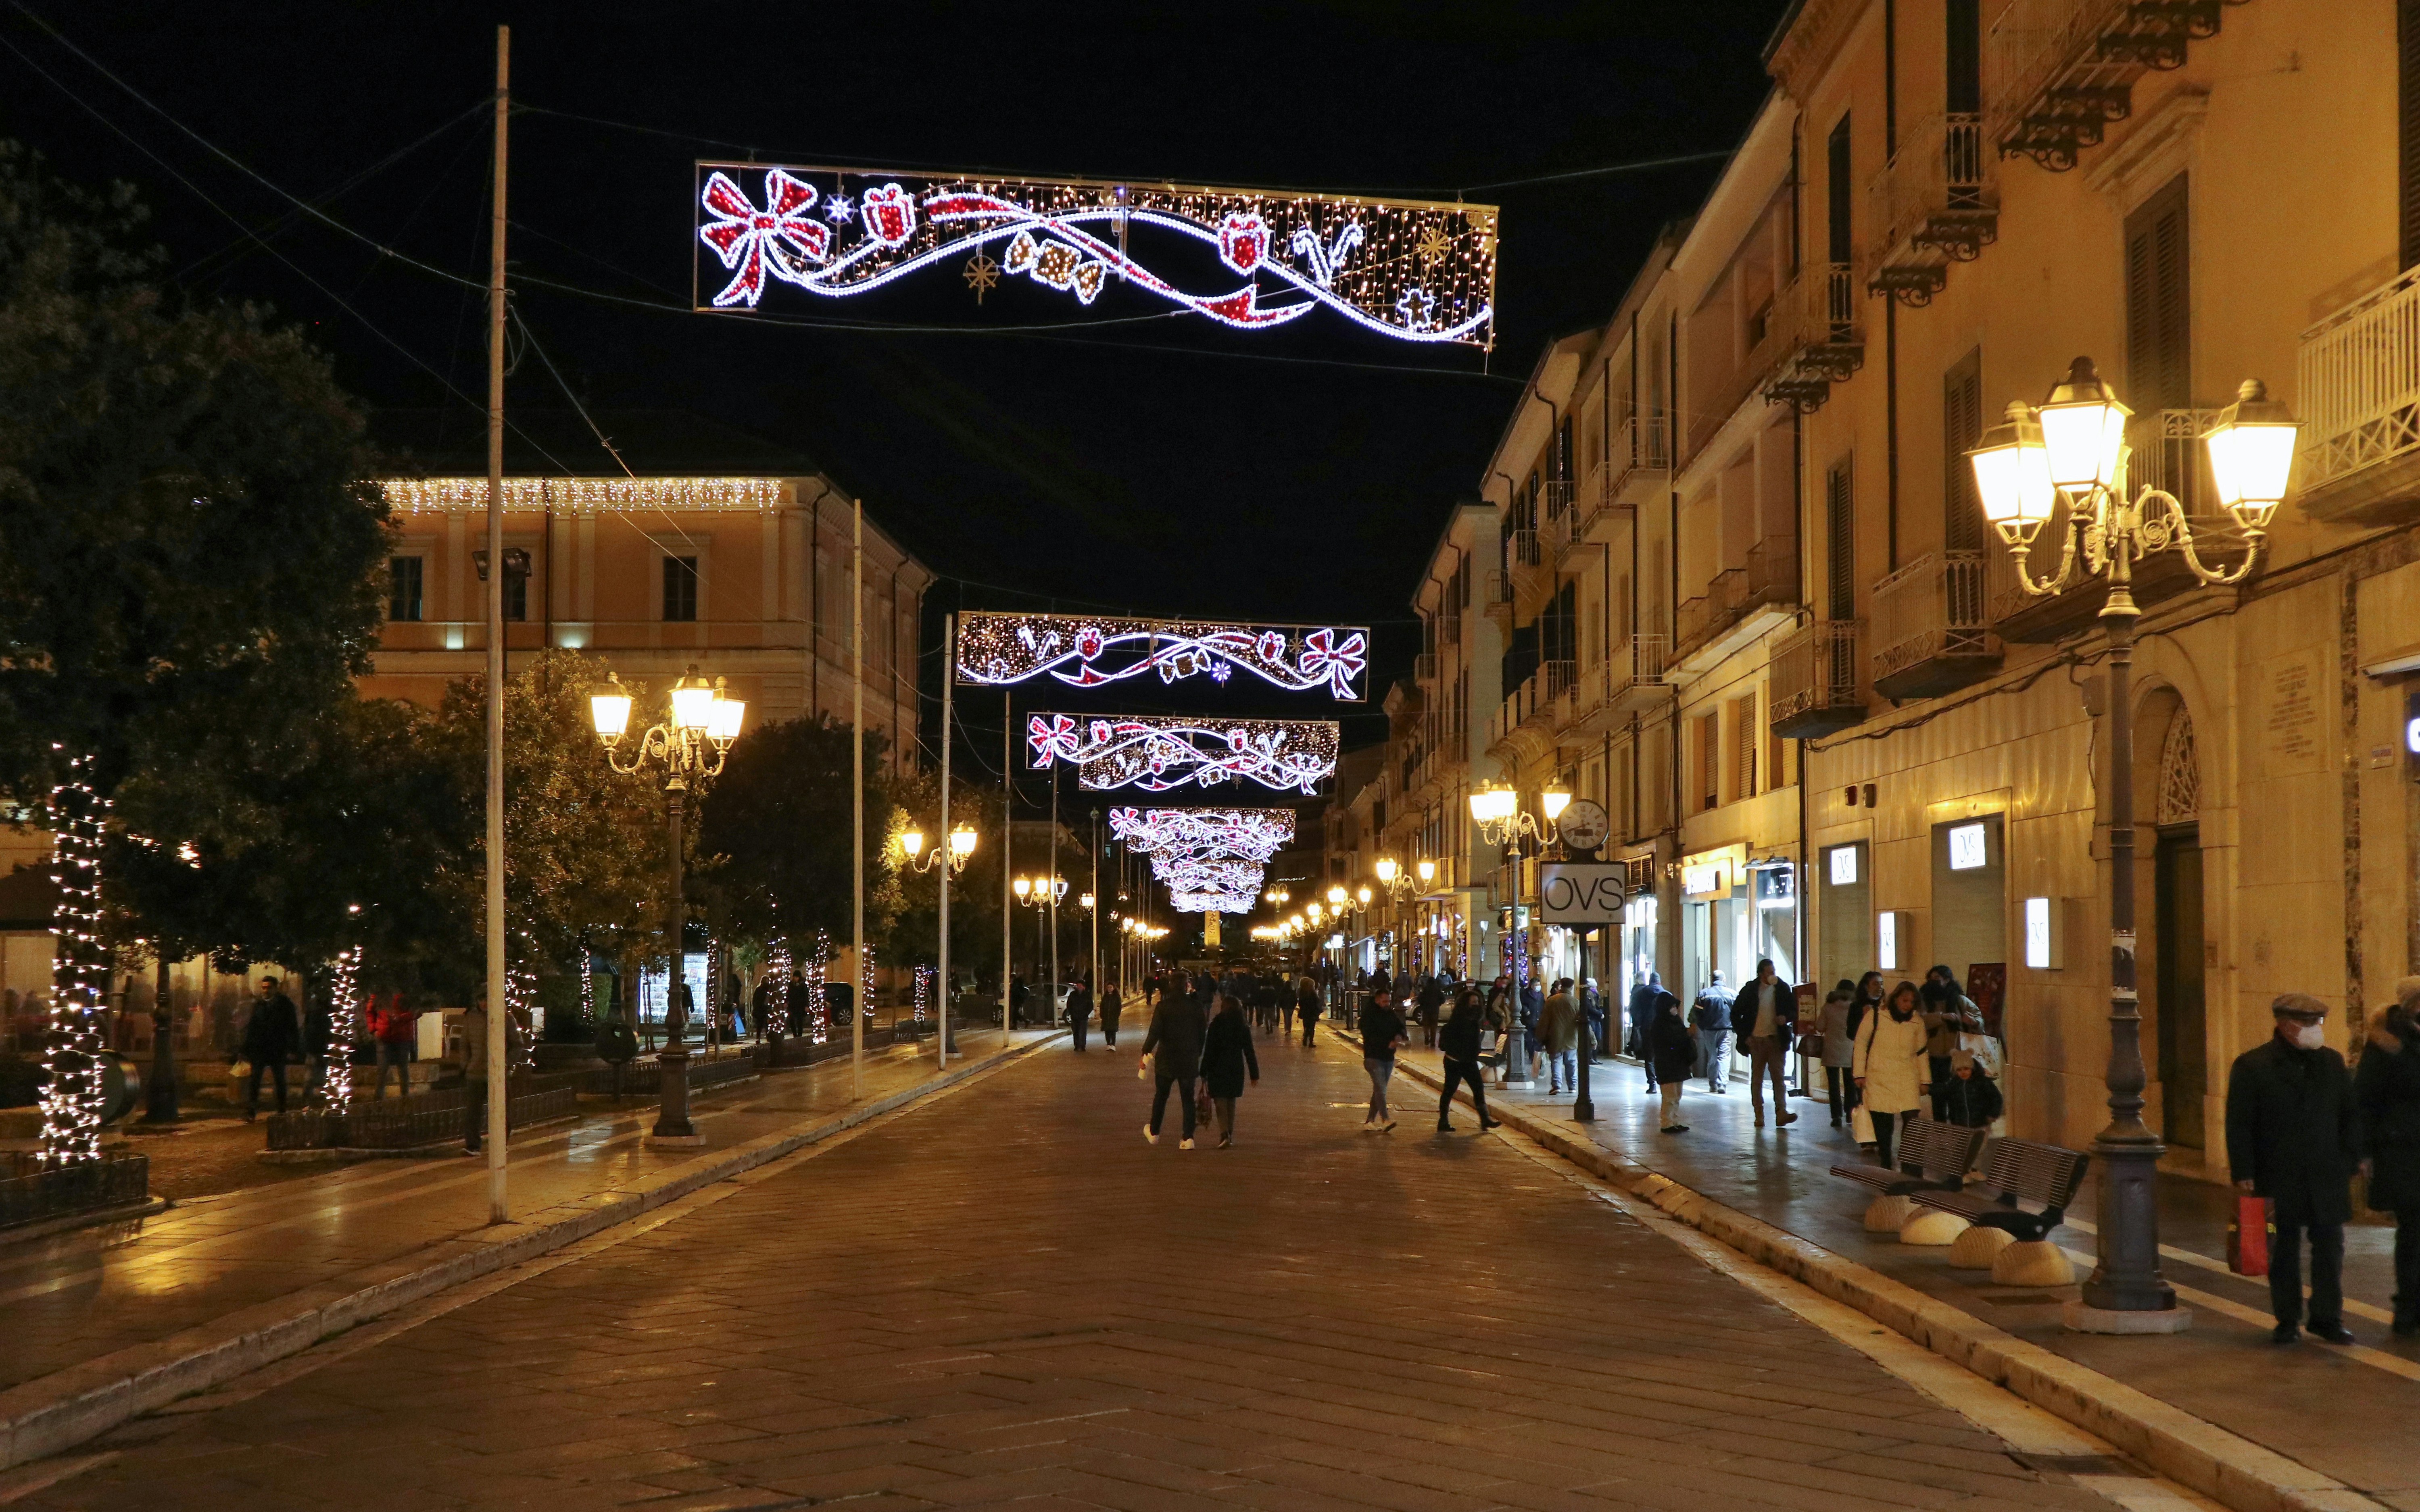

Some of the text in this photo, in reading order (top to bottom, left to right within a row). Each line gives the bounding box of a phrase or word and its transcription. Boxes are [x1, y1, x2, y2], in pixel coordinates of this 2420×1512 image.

[1959, 833, 1976, 862] OVS
[1838, 855, 1850, 879] OVS
[1545, 877, 1623, 911] OVS
[1883, 933, 1893, 950] OVS
[2031, 922, 2046, 944] OVS
